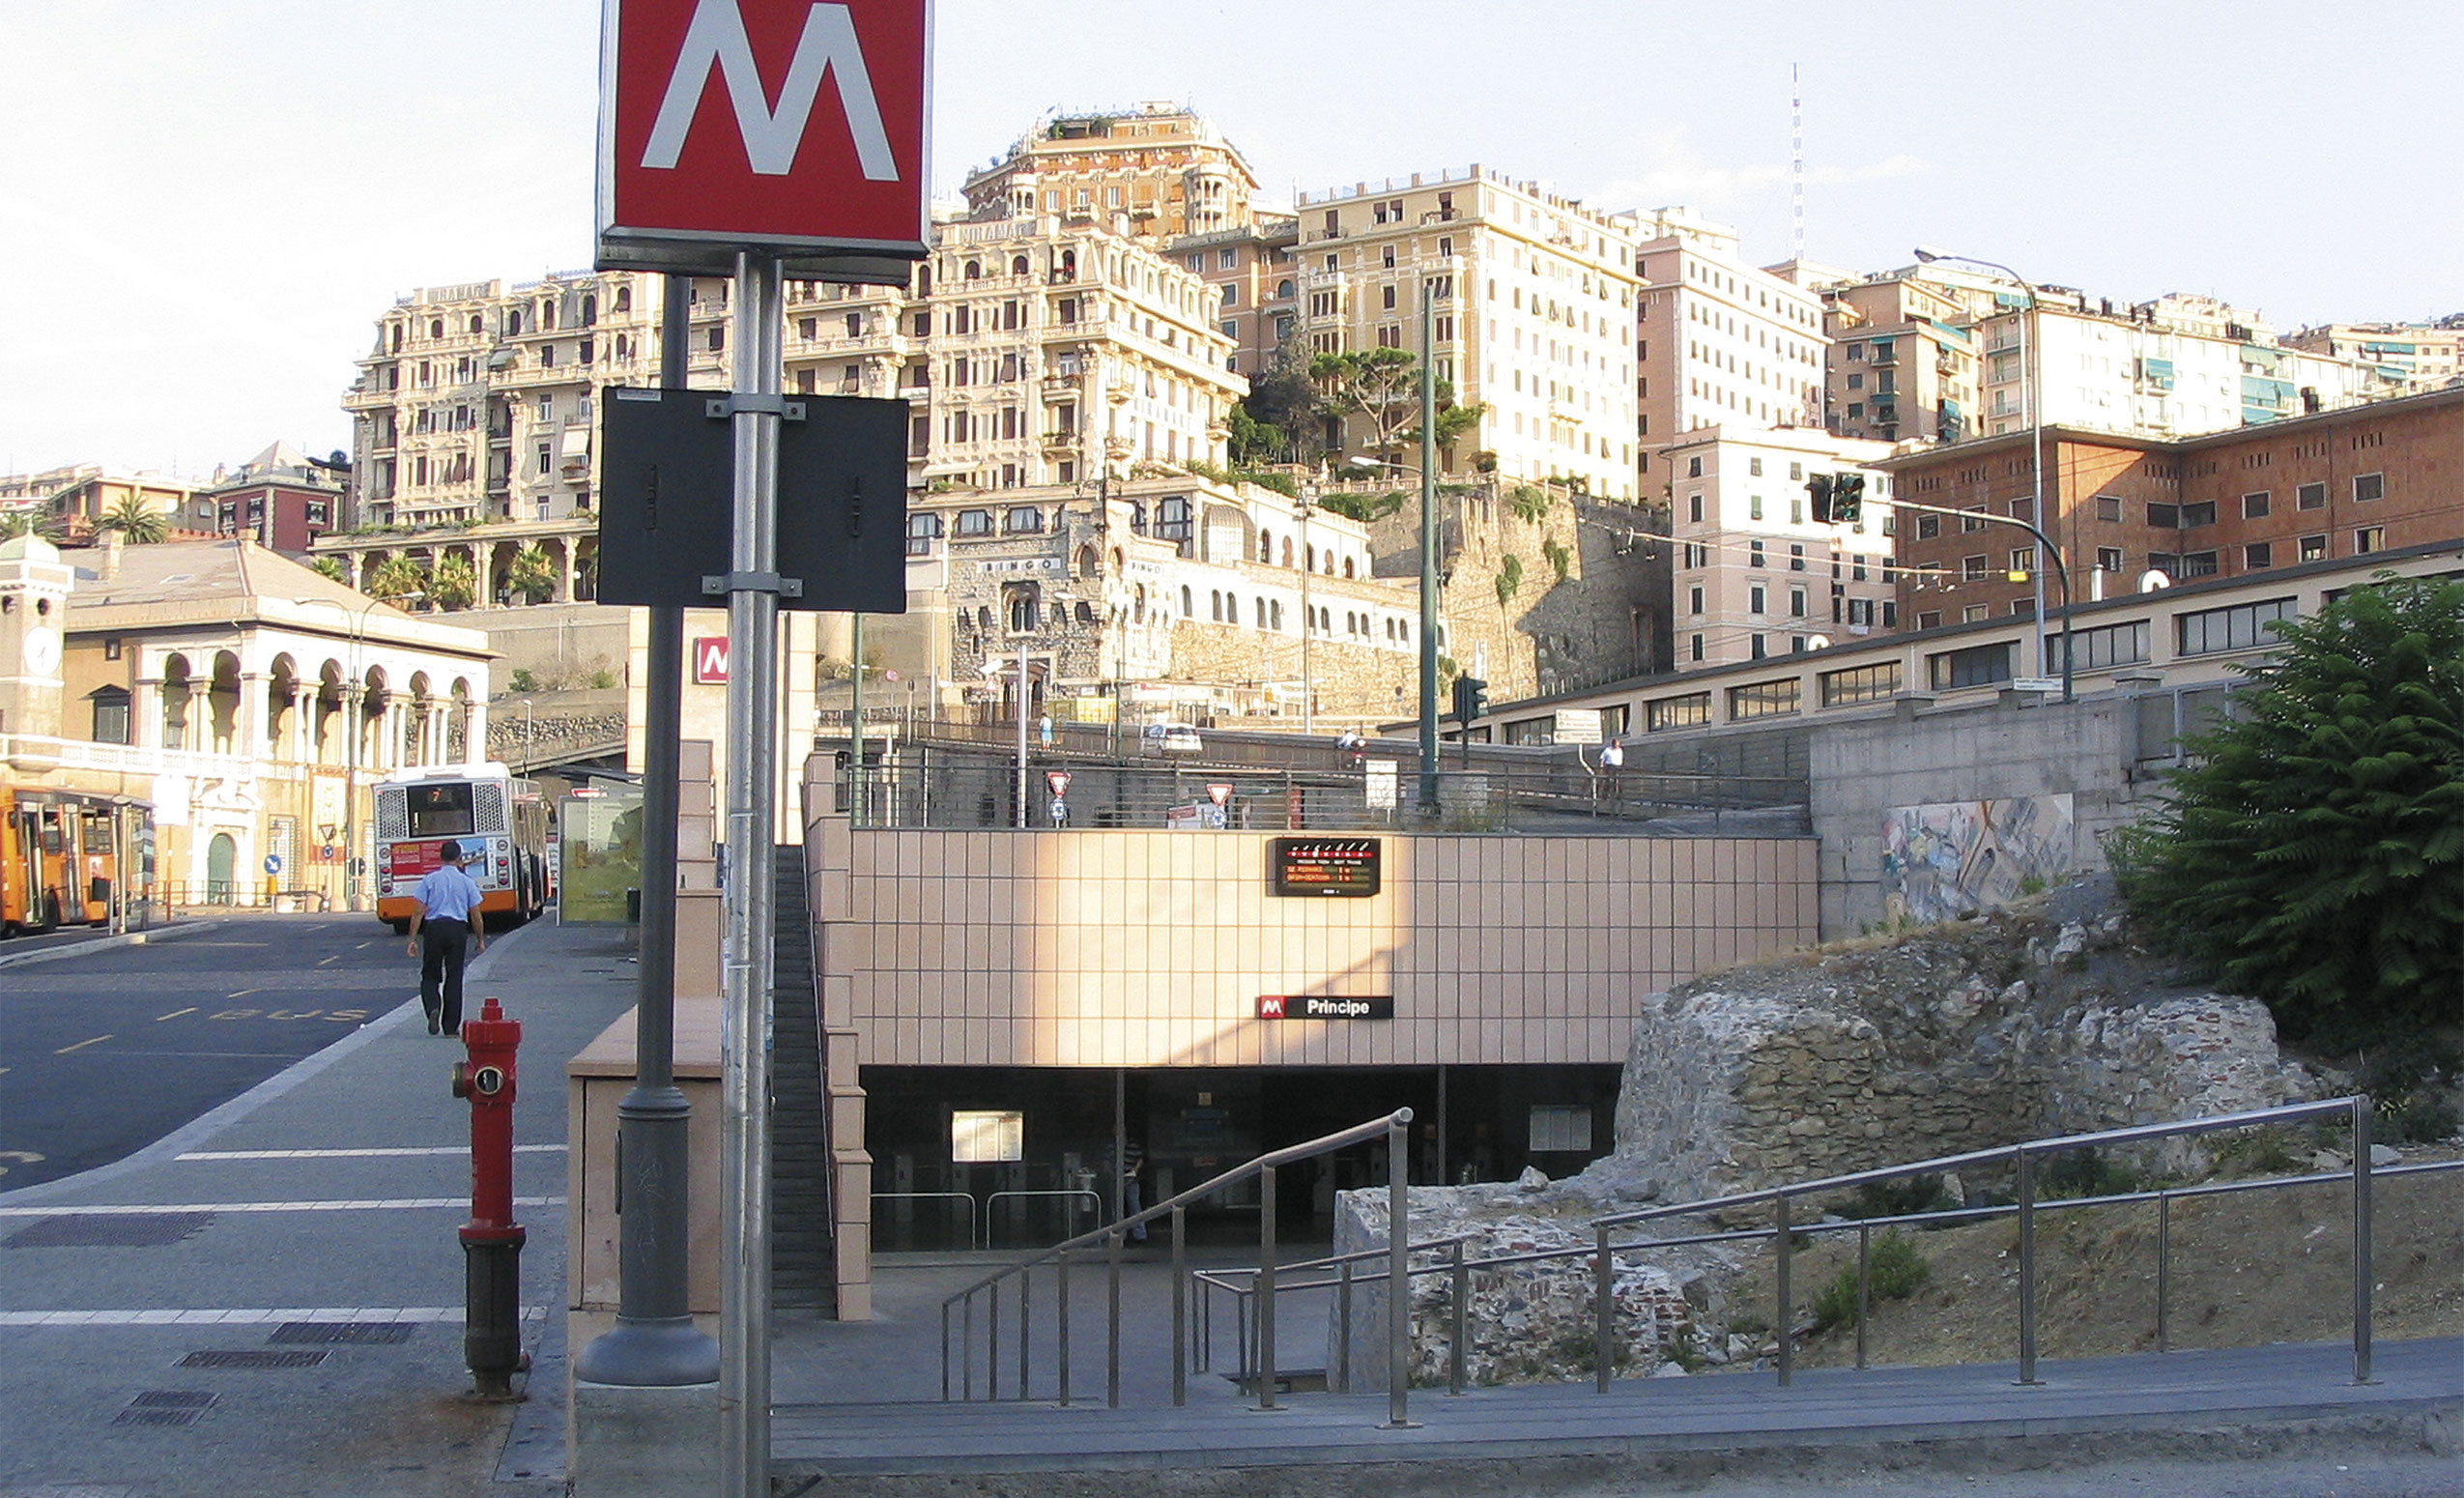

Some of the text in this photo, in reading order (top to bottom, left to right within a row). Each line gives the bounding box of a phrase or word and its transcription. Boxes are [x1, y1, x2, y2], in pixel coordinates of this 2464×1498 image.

[640, 0, 900, 182] M
[1262, 998, 1370, 1018] M Principe
